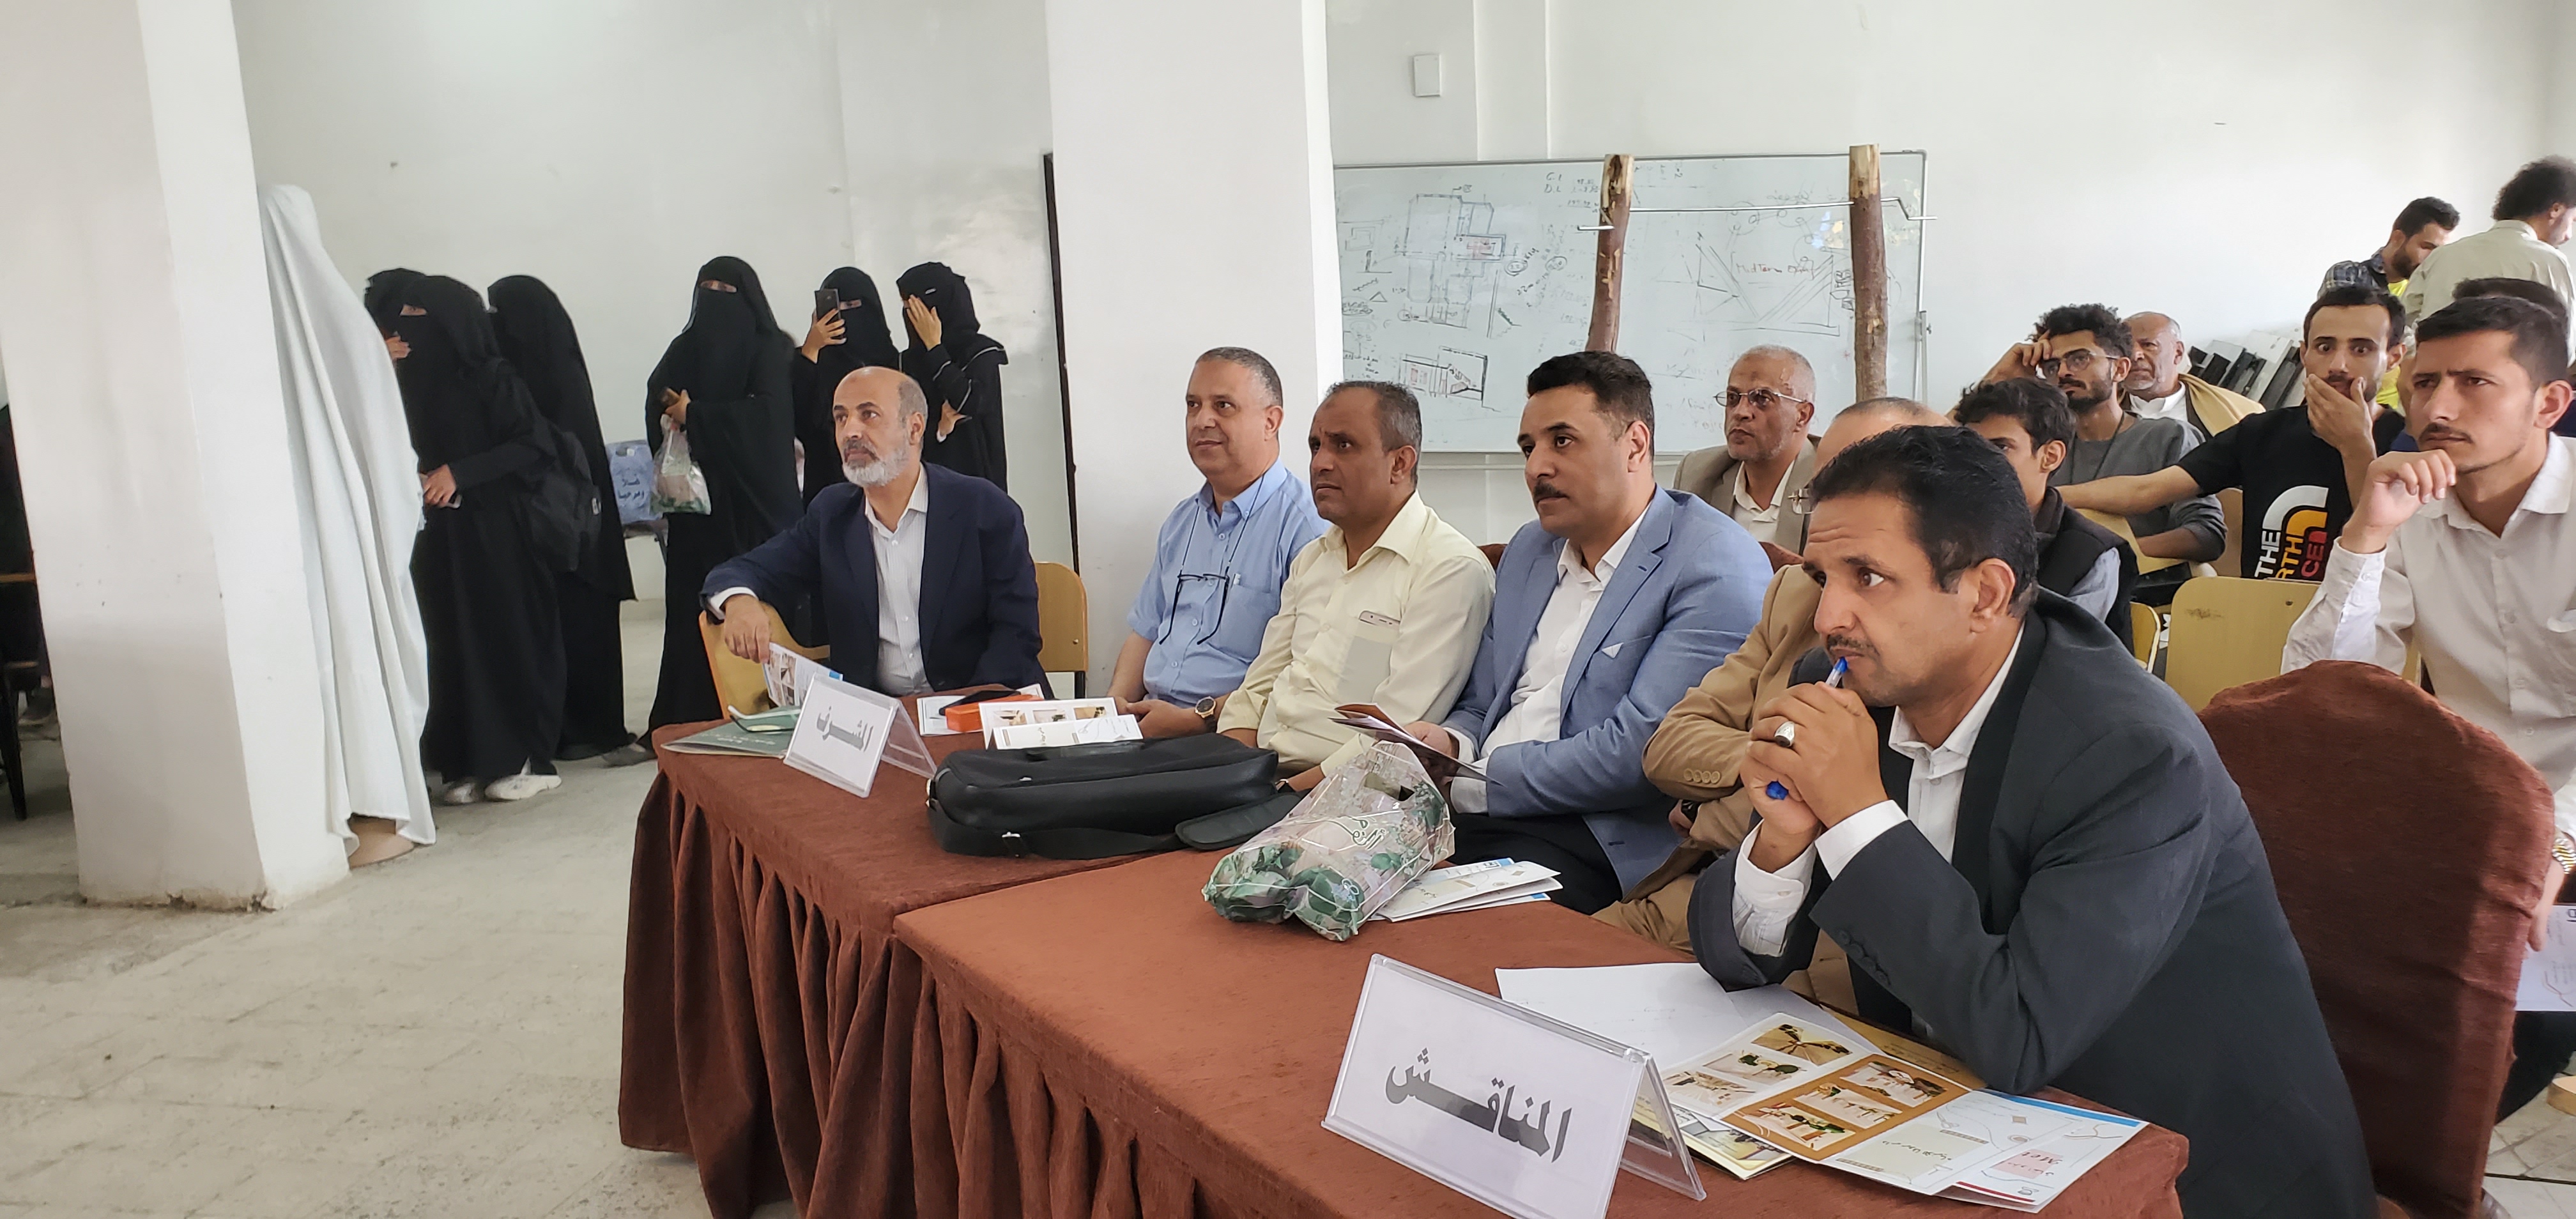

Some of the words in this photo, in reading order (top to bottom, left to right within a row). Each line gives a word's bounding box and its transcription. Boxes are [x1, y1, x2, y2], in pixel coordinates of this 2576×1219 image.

[2255, 531, 2281, 578] THE
[2275, 537, 2303, 579] RTH
[2301, 544, 2324, 577] CE
[1385, 1046, 1572, 1163] المناقش
